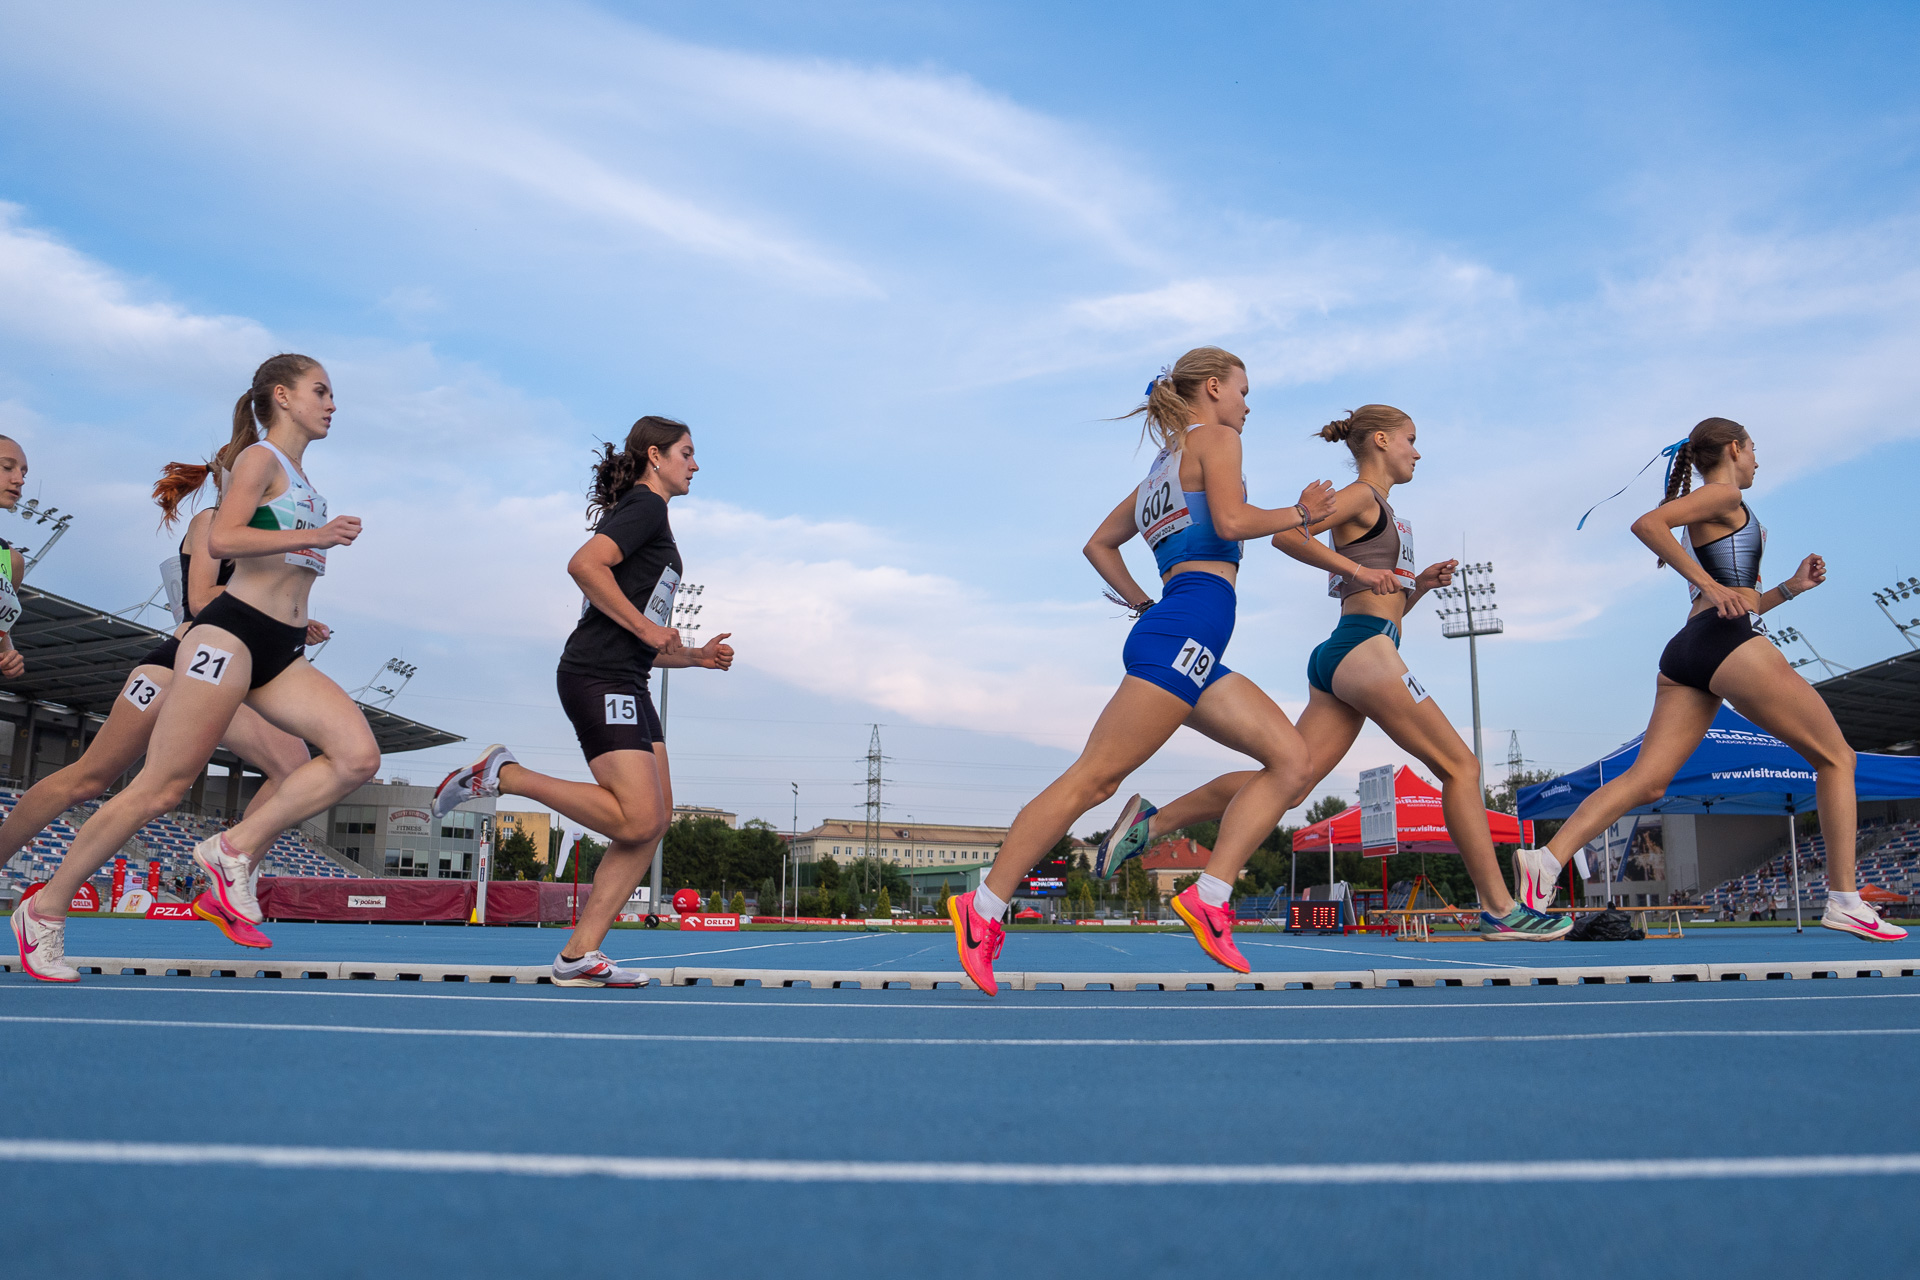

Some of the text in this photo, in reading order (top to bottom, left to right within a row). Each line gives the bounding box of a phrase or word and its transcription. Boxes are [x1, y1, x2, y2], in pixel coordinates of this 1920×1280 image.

[1142, 481, 1174, 528] 602
[1161, 524, 1176, 536] 2024
[190, 650, 226, 679] 21
[129, 679, 156, 705] 13
[606, 698, 636, 720] 15
[72, 900, 92, 908] ORLEN
[153, 906, 193, 917] PZLA
